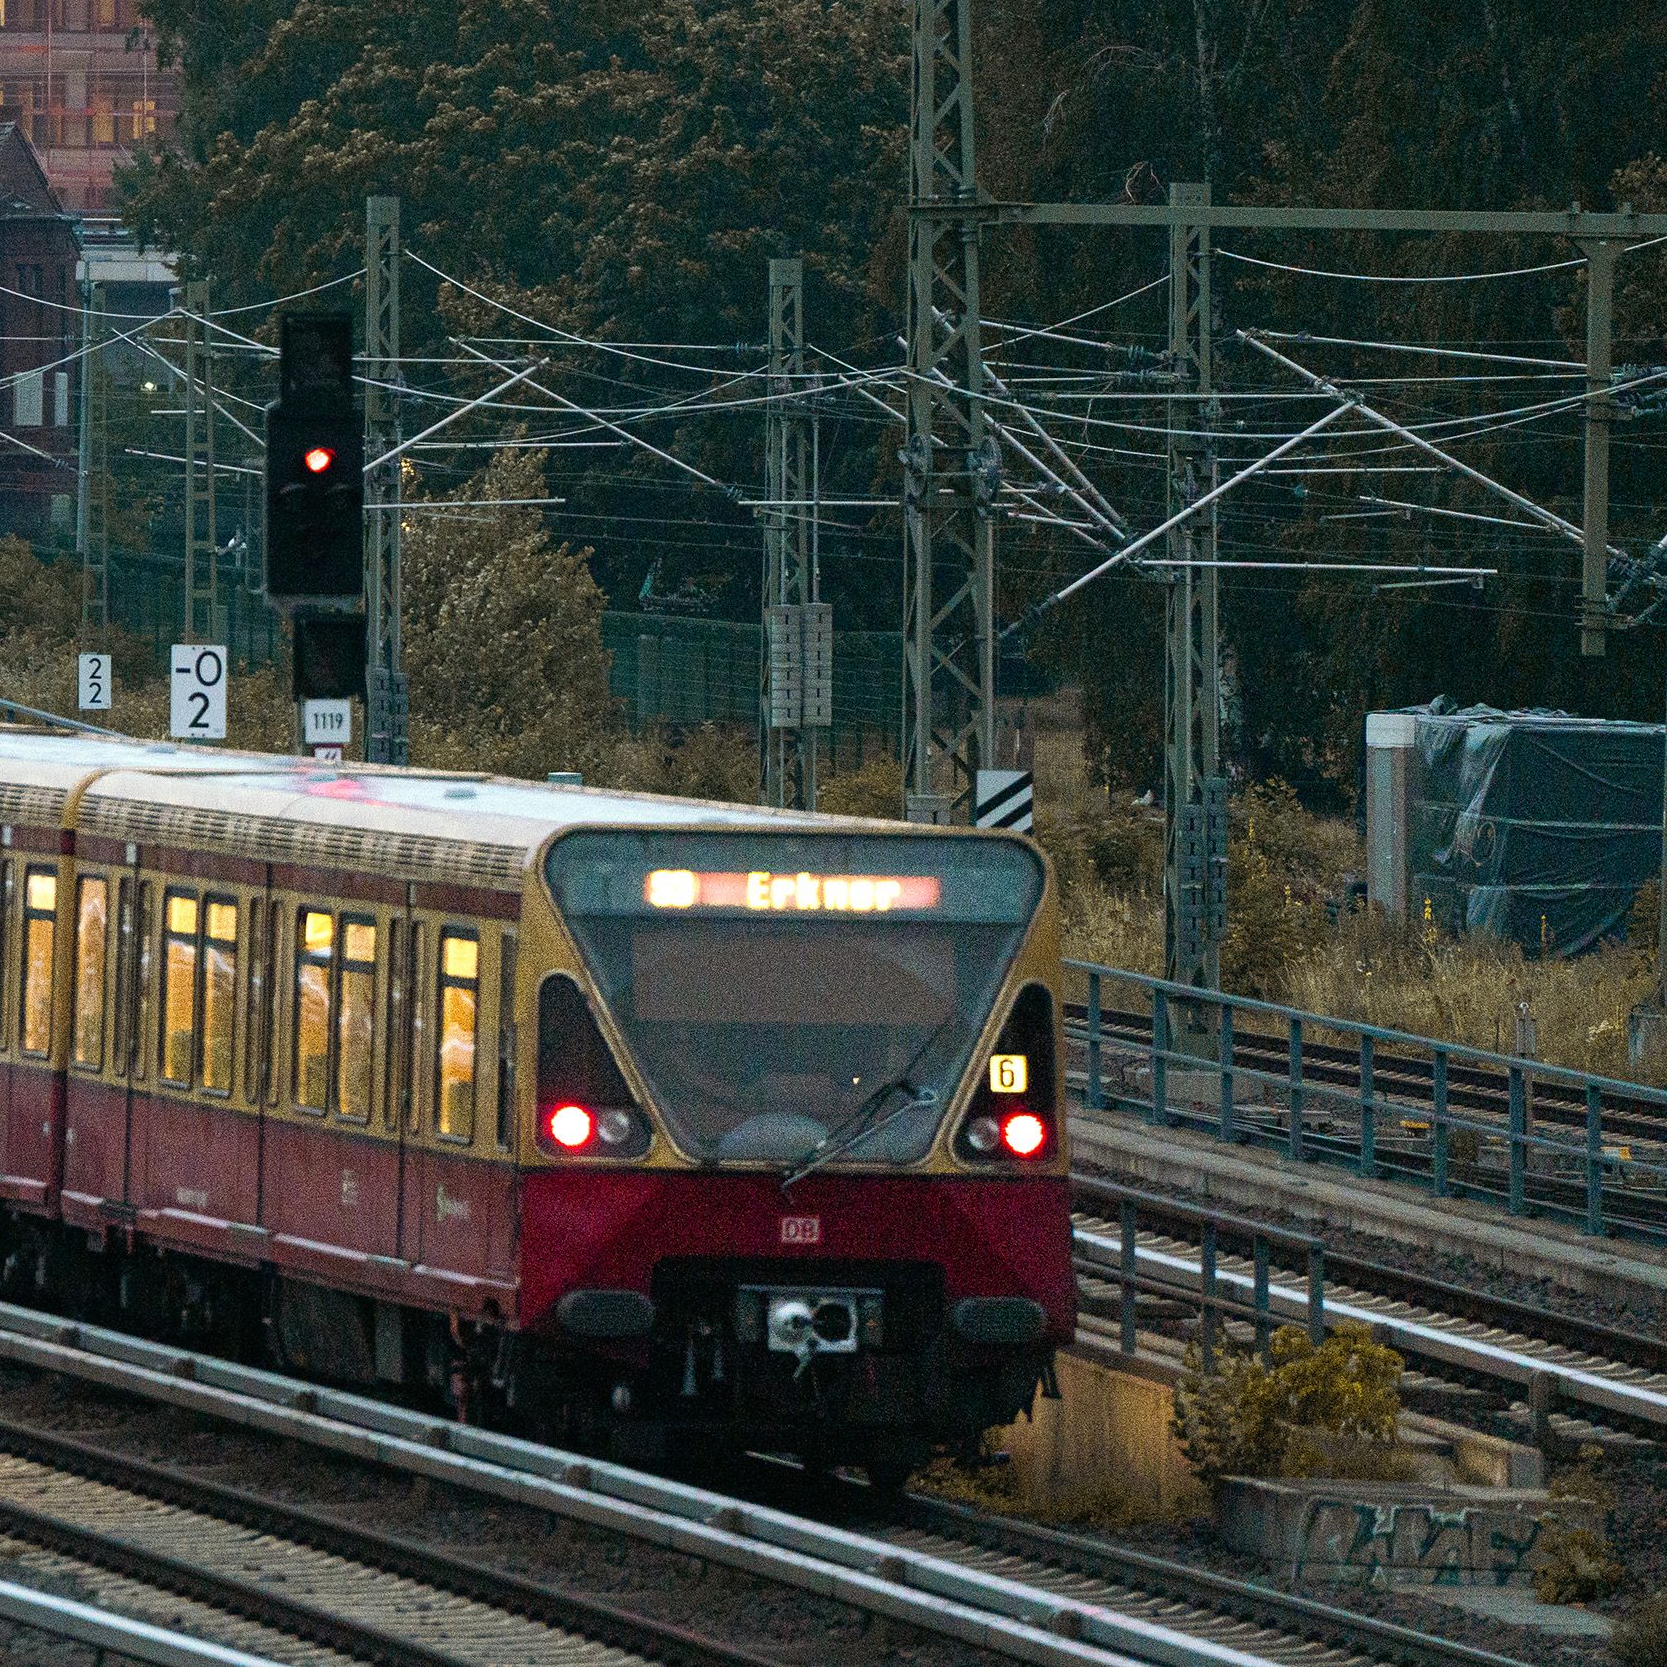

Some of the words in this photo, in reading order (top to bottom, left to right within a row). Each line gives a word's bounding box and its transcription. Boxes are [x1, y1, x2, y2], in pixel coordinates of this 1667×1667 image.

[89, 658, 102, 679] 2
[176, 651, 222, 686] -0
[89, 682, 102, 704] 2
[188, 692, 209, 728] 2
[313, 712, 343, 730] 1119
[747, 872, 901, 910] Erkner
[999, 1058, 1015, 1087] 6
[783, 1218, 817, 1242] DB
